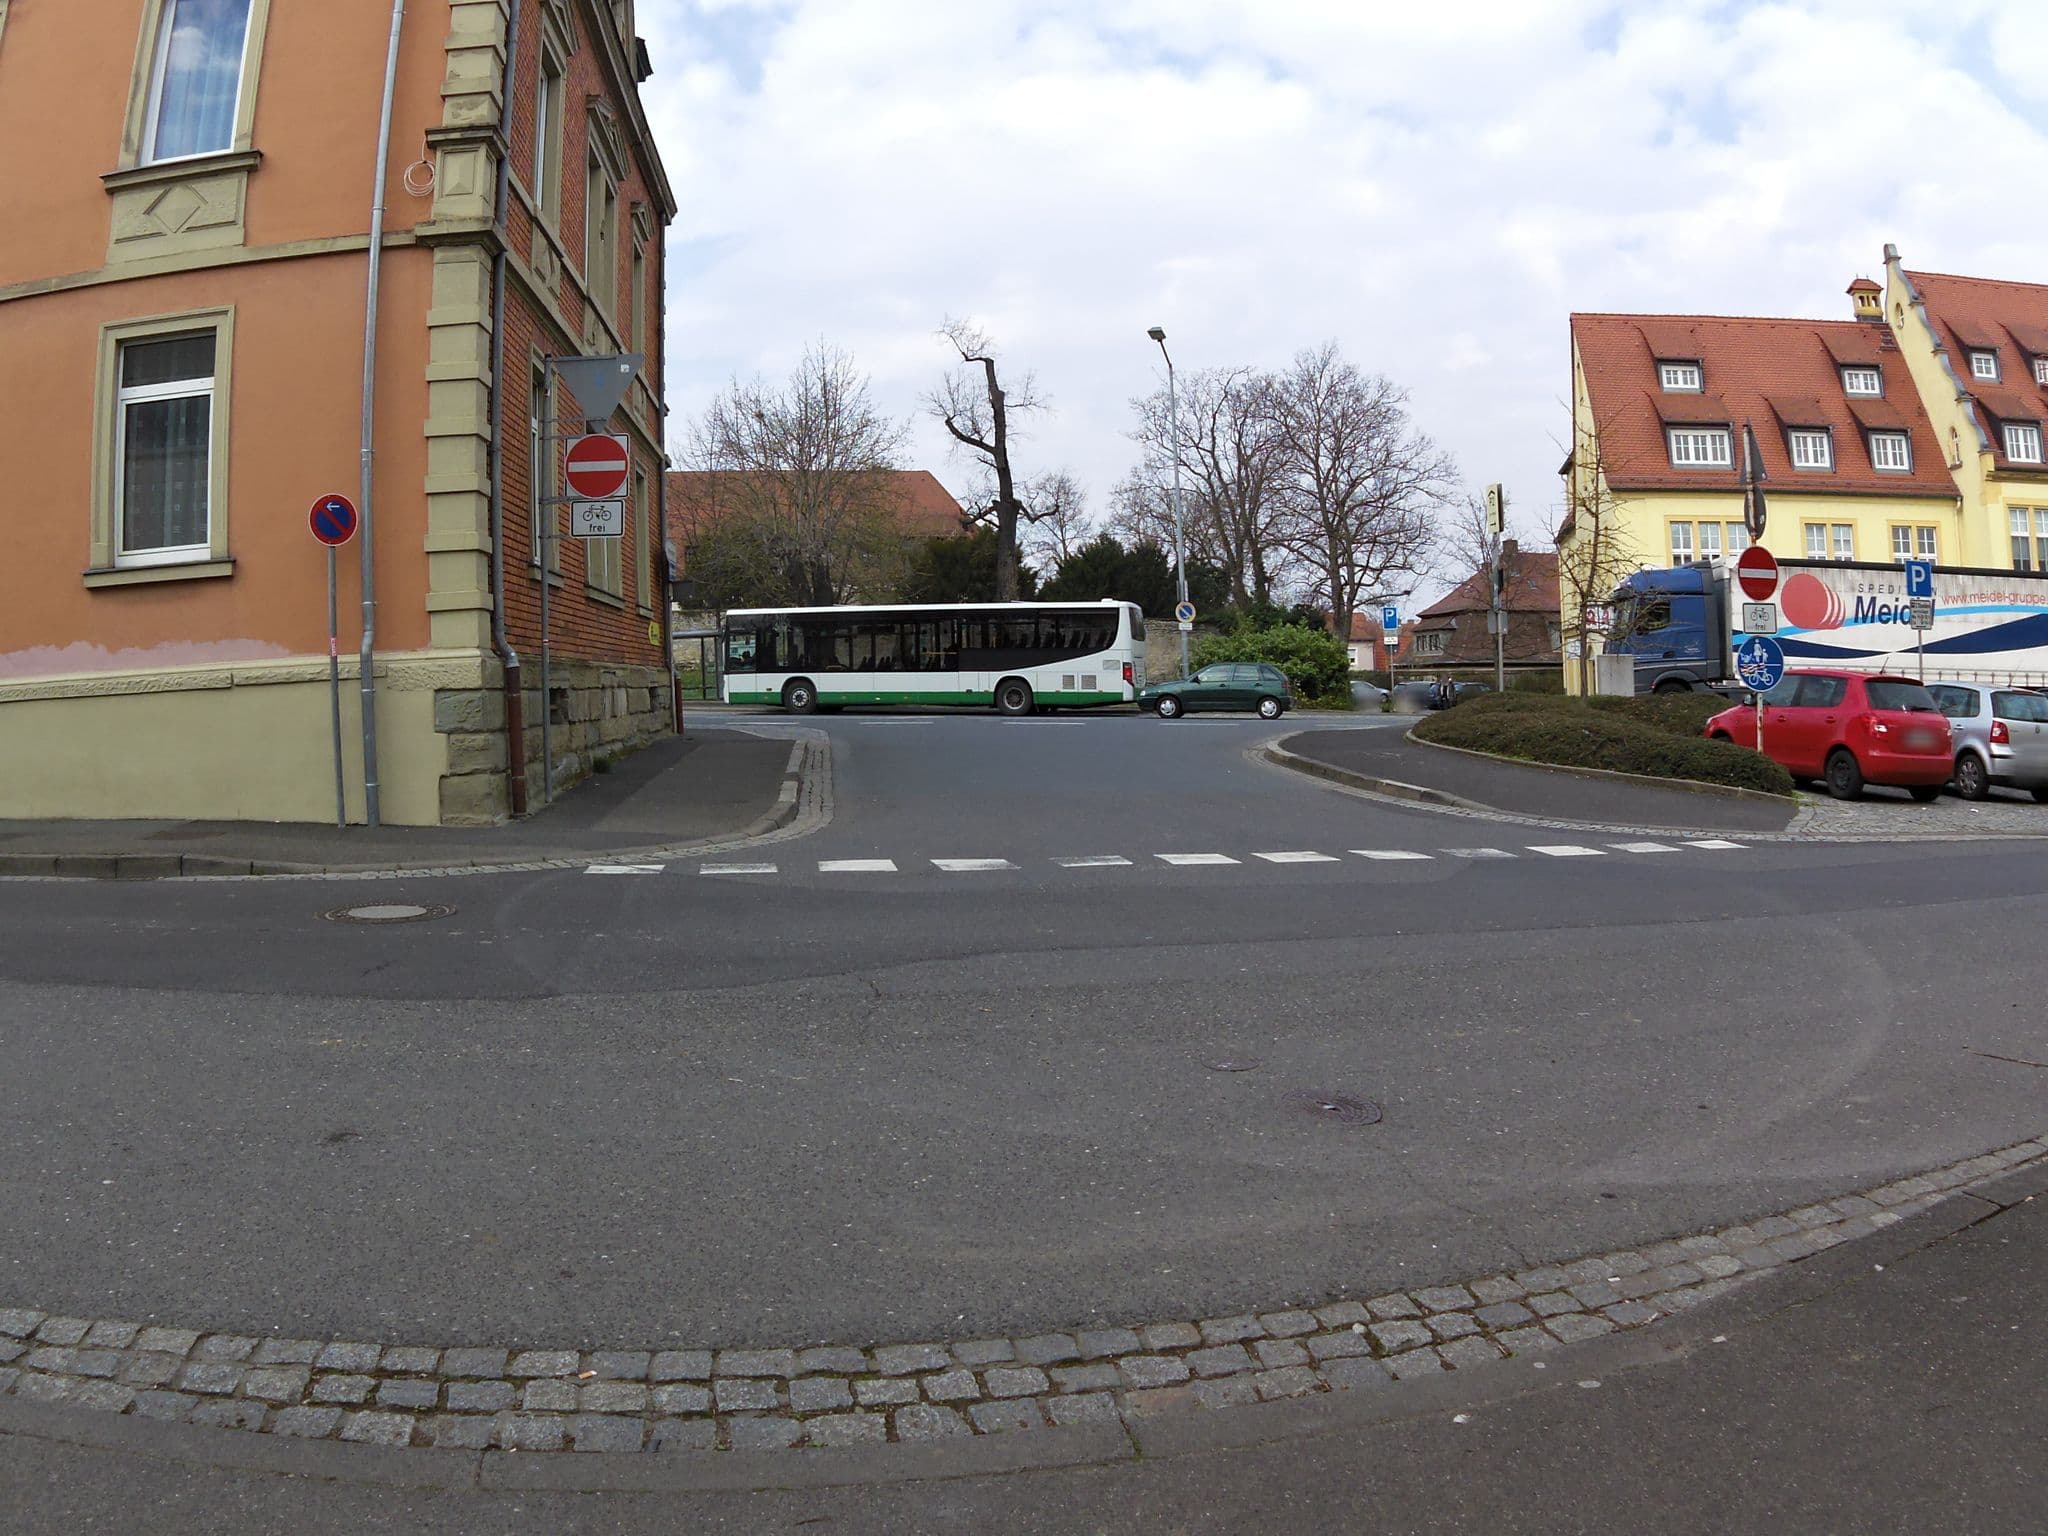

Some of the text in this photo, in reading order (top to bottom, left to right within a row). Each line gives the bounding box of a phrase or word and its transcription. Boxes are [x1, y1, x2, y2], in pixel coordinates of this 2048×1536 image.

[589, 523, 606, 532] frei
[1911, 565, 1926, 592] P
[1858, 583, 1937, 596] SPEDIN
[1385, 609, 1395, 622] P
[1854, 596, 1936, 626] Meidl
